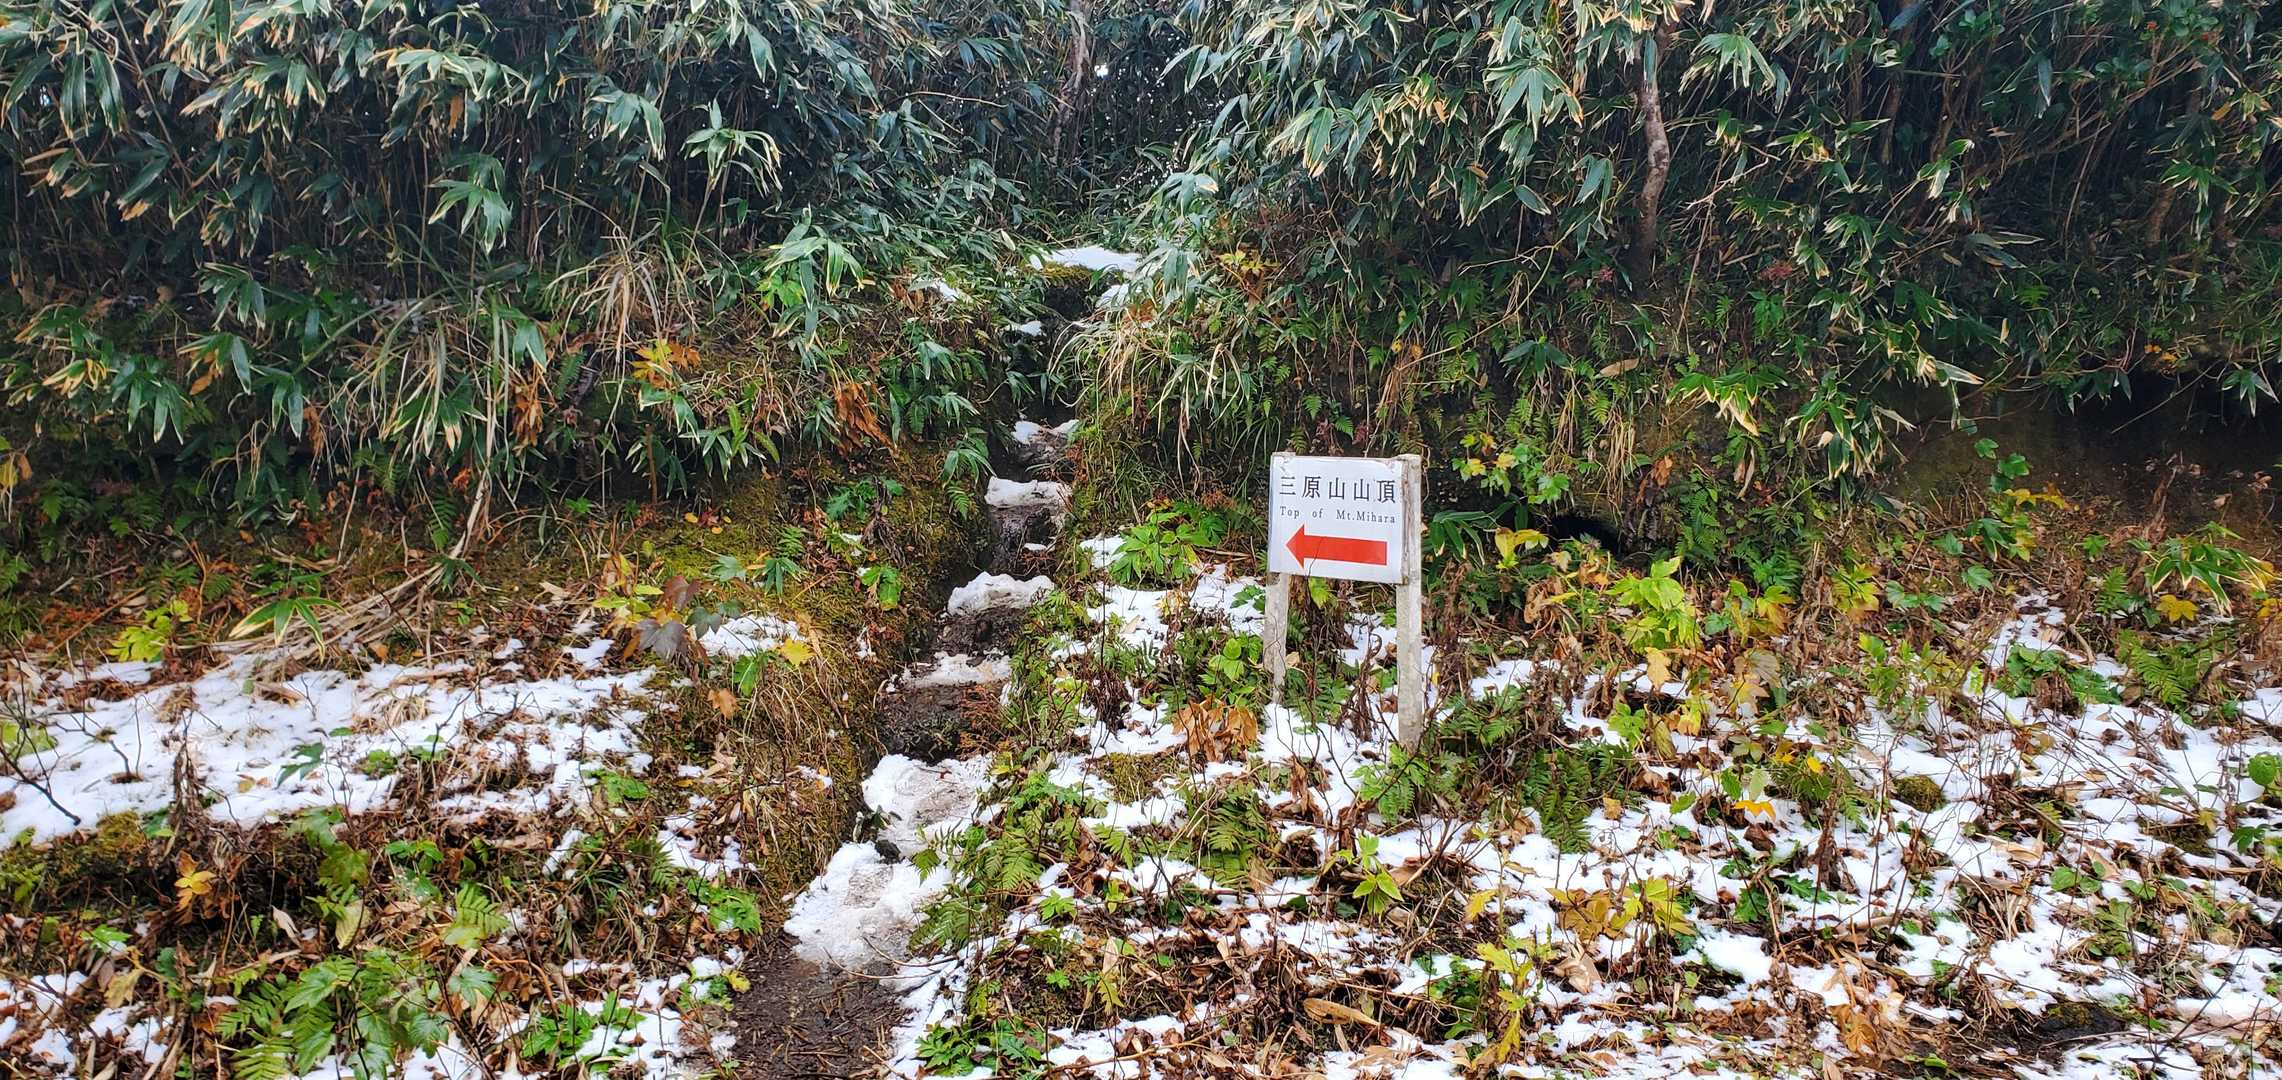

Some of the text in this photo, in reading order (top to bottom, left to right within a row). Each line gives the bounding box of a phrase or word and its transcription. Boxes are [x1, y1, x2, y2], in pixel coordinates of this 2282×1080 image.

[1279, 475, 1396, 504] 三原山山頂
[1280, 506, 1396, 523] Top of Mt.Mihara
